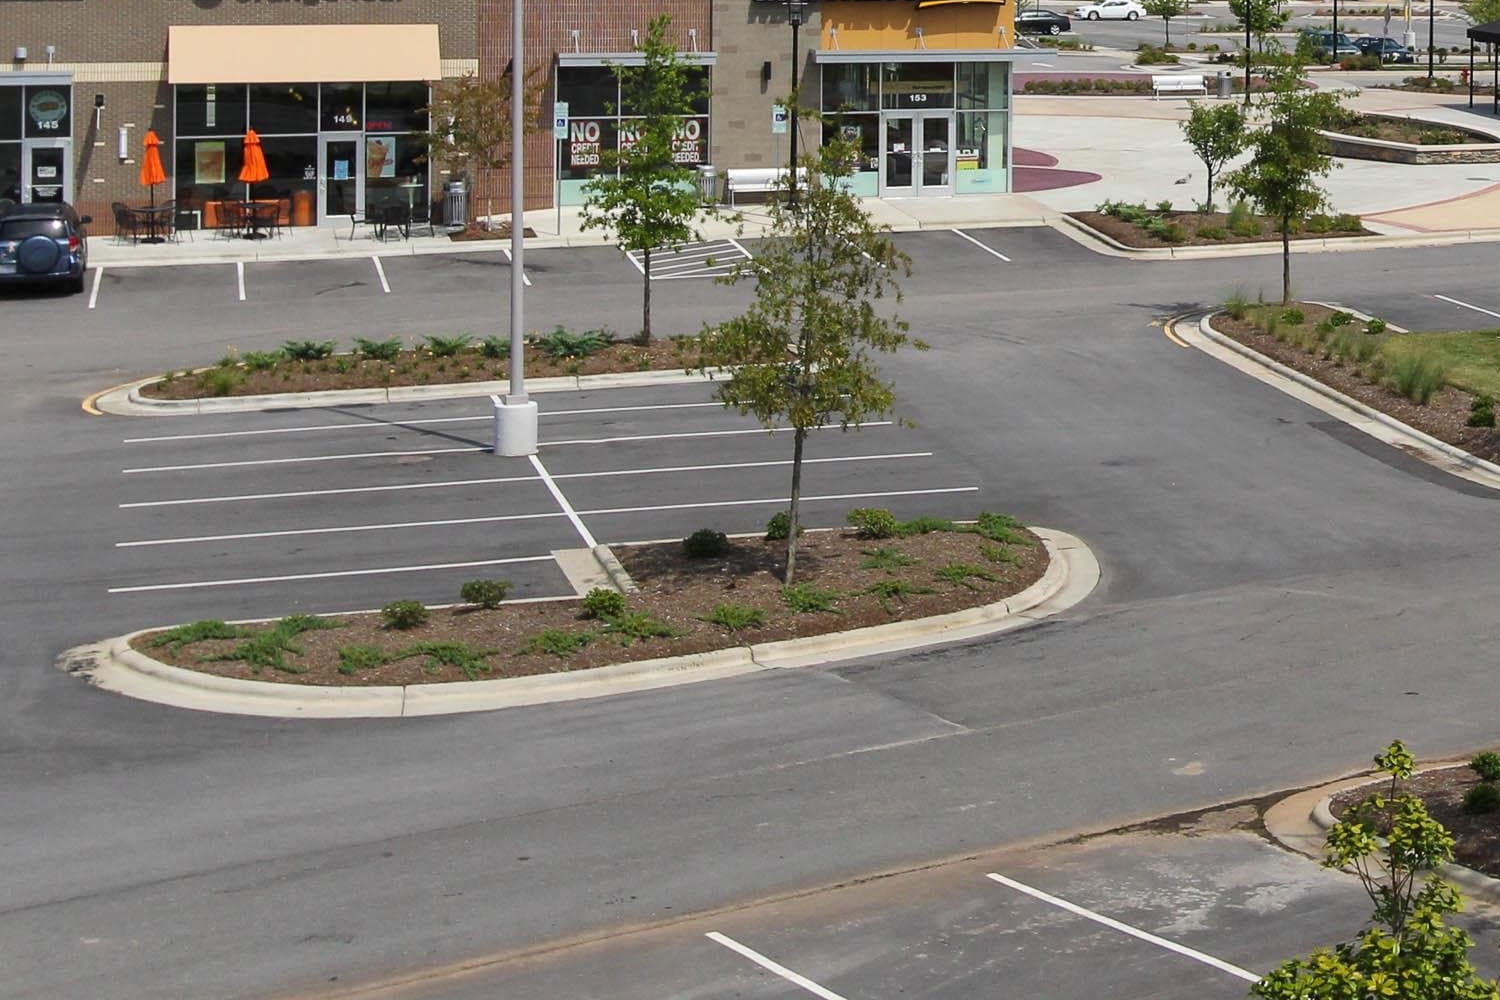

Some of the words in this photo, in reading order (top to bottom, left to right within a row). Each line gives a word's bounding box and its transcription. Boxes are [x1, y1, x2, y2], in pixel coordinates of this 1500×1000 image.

[909, 94, 927, 102] 153
[333, 115, 353, 124] 149
[570, 121, 600, 143] NO
[571, 143, 600, 154] CREDIT
[571, 154, 600, 166] NEEDED
